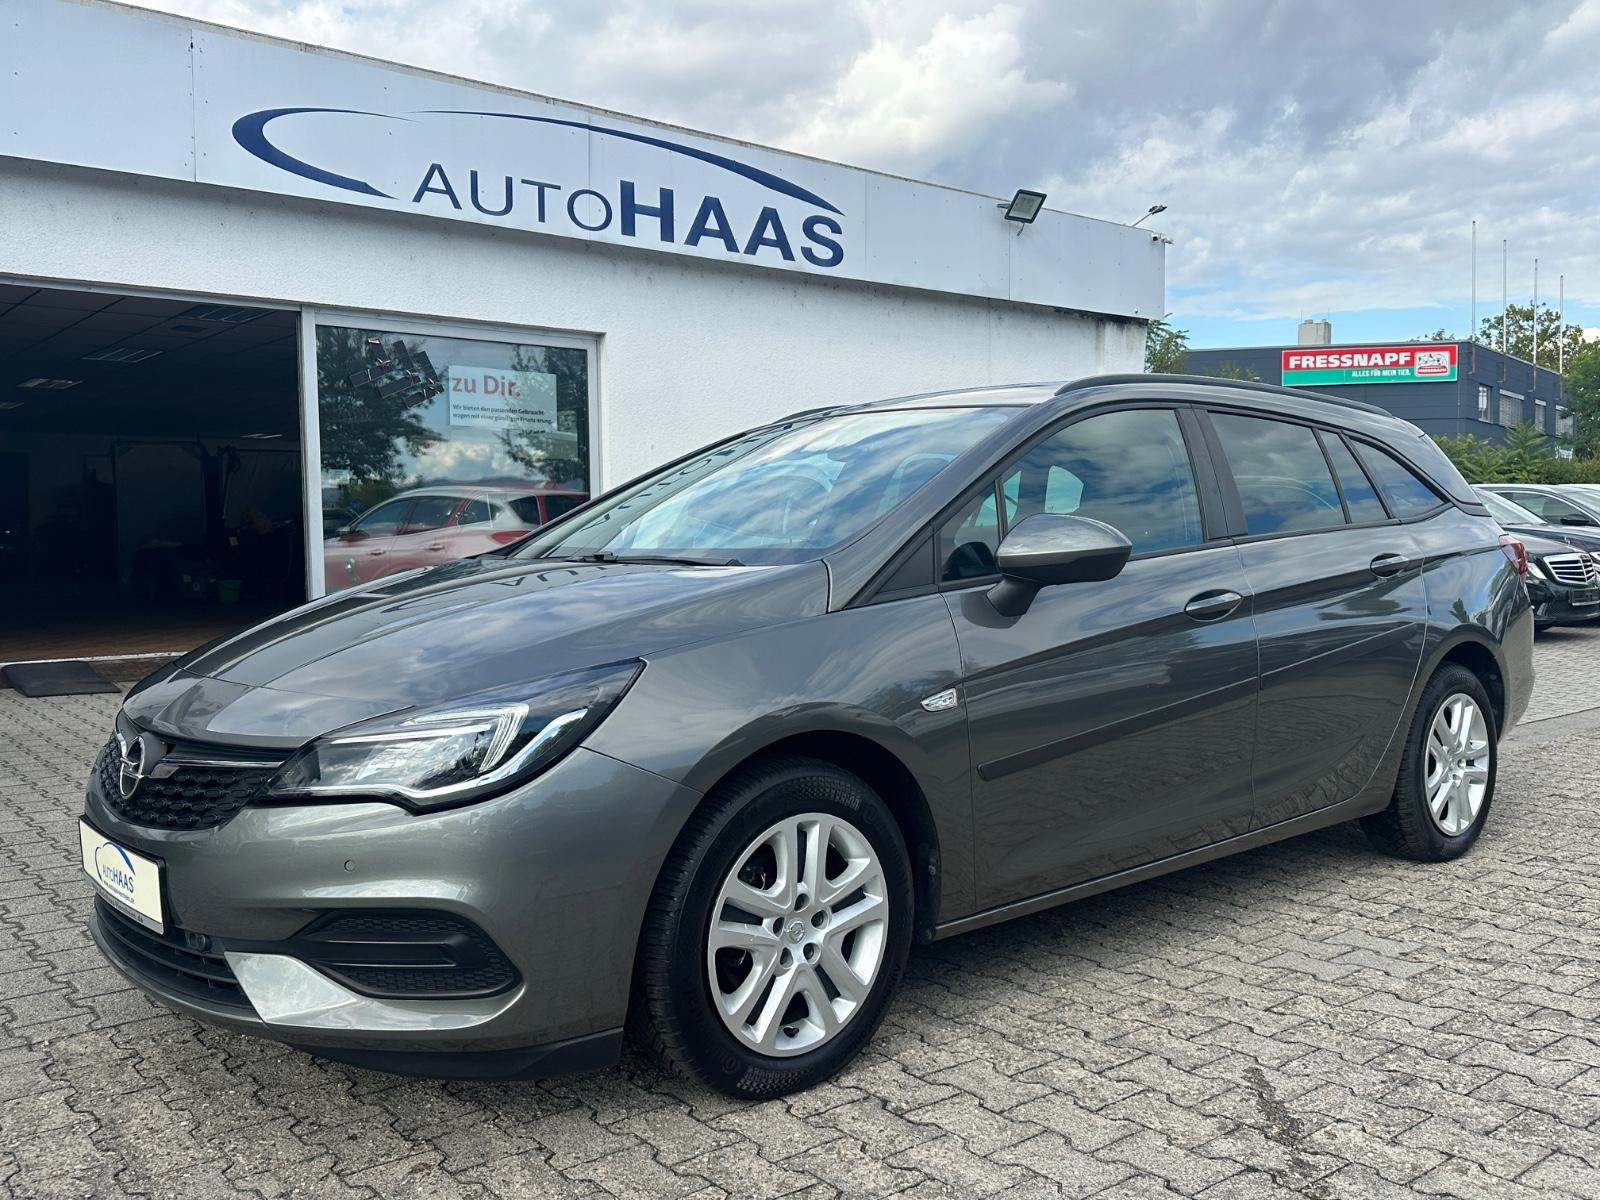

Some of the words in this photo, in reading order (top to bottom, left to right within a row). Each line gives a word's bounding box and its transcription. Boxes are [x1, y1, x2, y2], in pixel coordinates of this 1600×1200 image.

[1289, 352, 1411, 369] FRESSNAPF
[1352, 369, 1370, 377] ALLES
[1371, 368, 1381, 377] FÜR
[1382, 368, 1397, 377] MEIN
[452, 378, 476, 393] zu
[483, 375, 521, 397] Dir.
